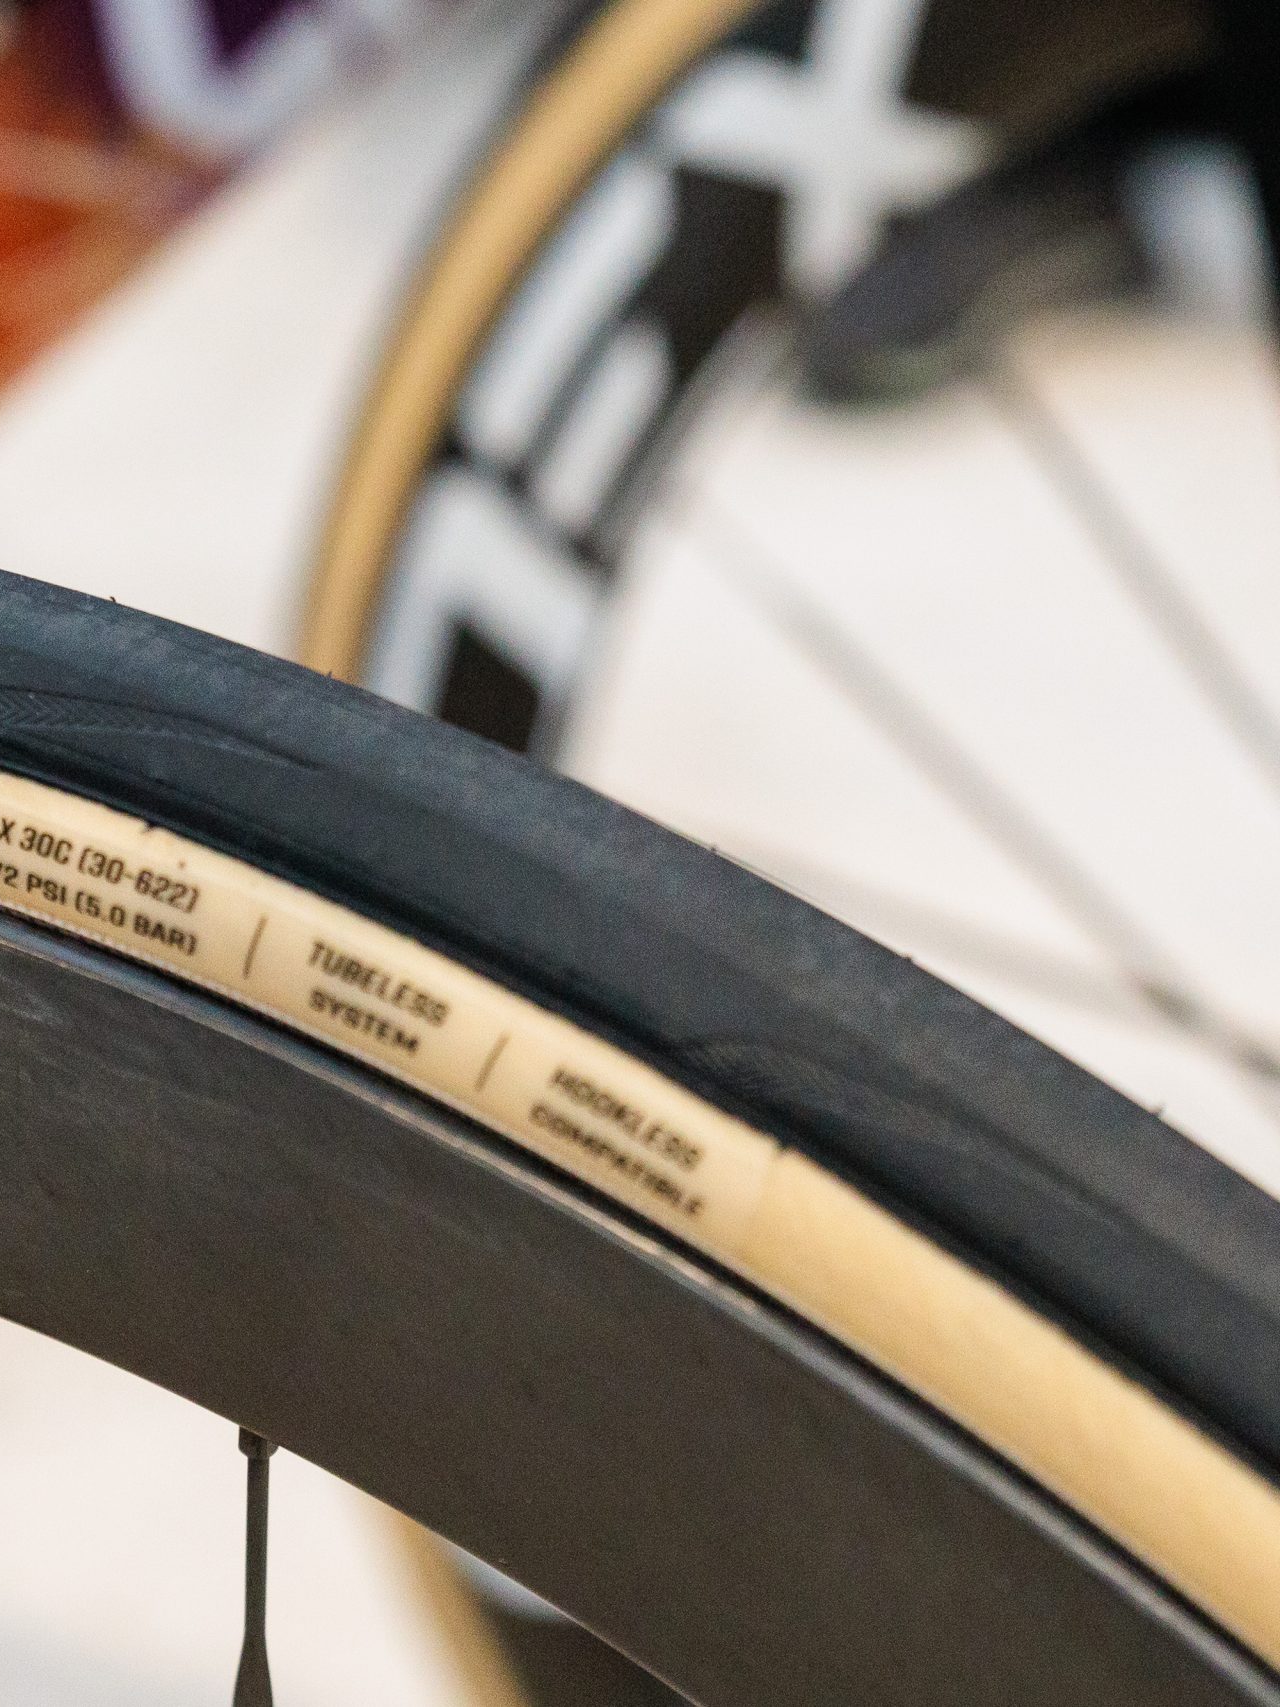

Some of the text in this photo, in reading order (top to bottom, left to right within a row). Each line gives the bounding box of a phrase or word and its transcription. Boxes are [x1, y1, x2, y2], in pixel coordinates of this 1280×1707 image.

[20, 827, 72, 865] 30C
[26, 873, 68, 906] PSI
[307, 941, 450, 1028] TUBELESS
[310, 989, 420, 1055] SYSTEM
[551, 1066, 706, 1174] HOOKLESS
[528, 1104, 707, 1218] COMPATIBLE
